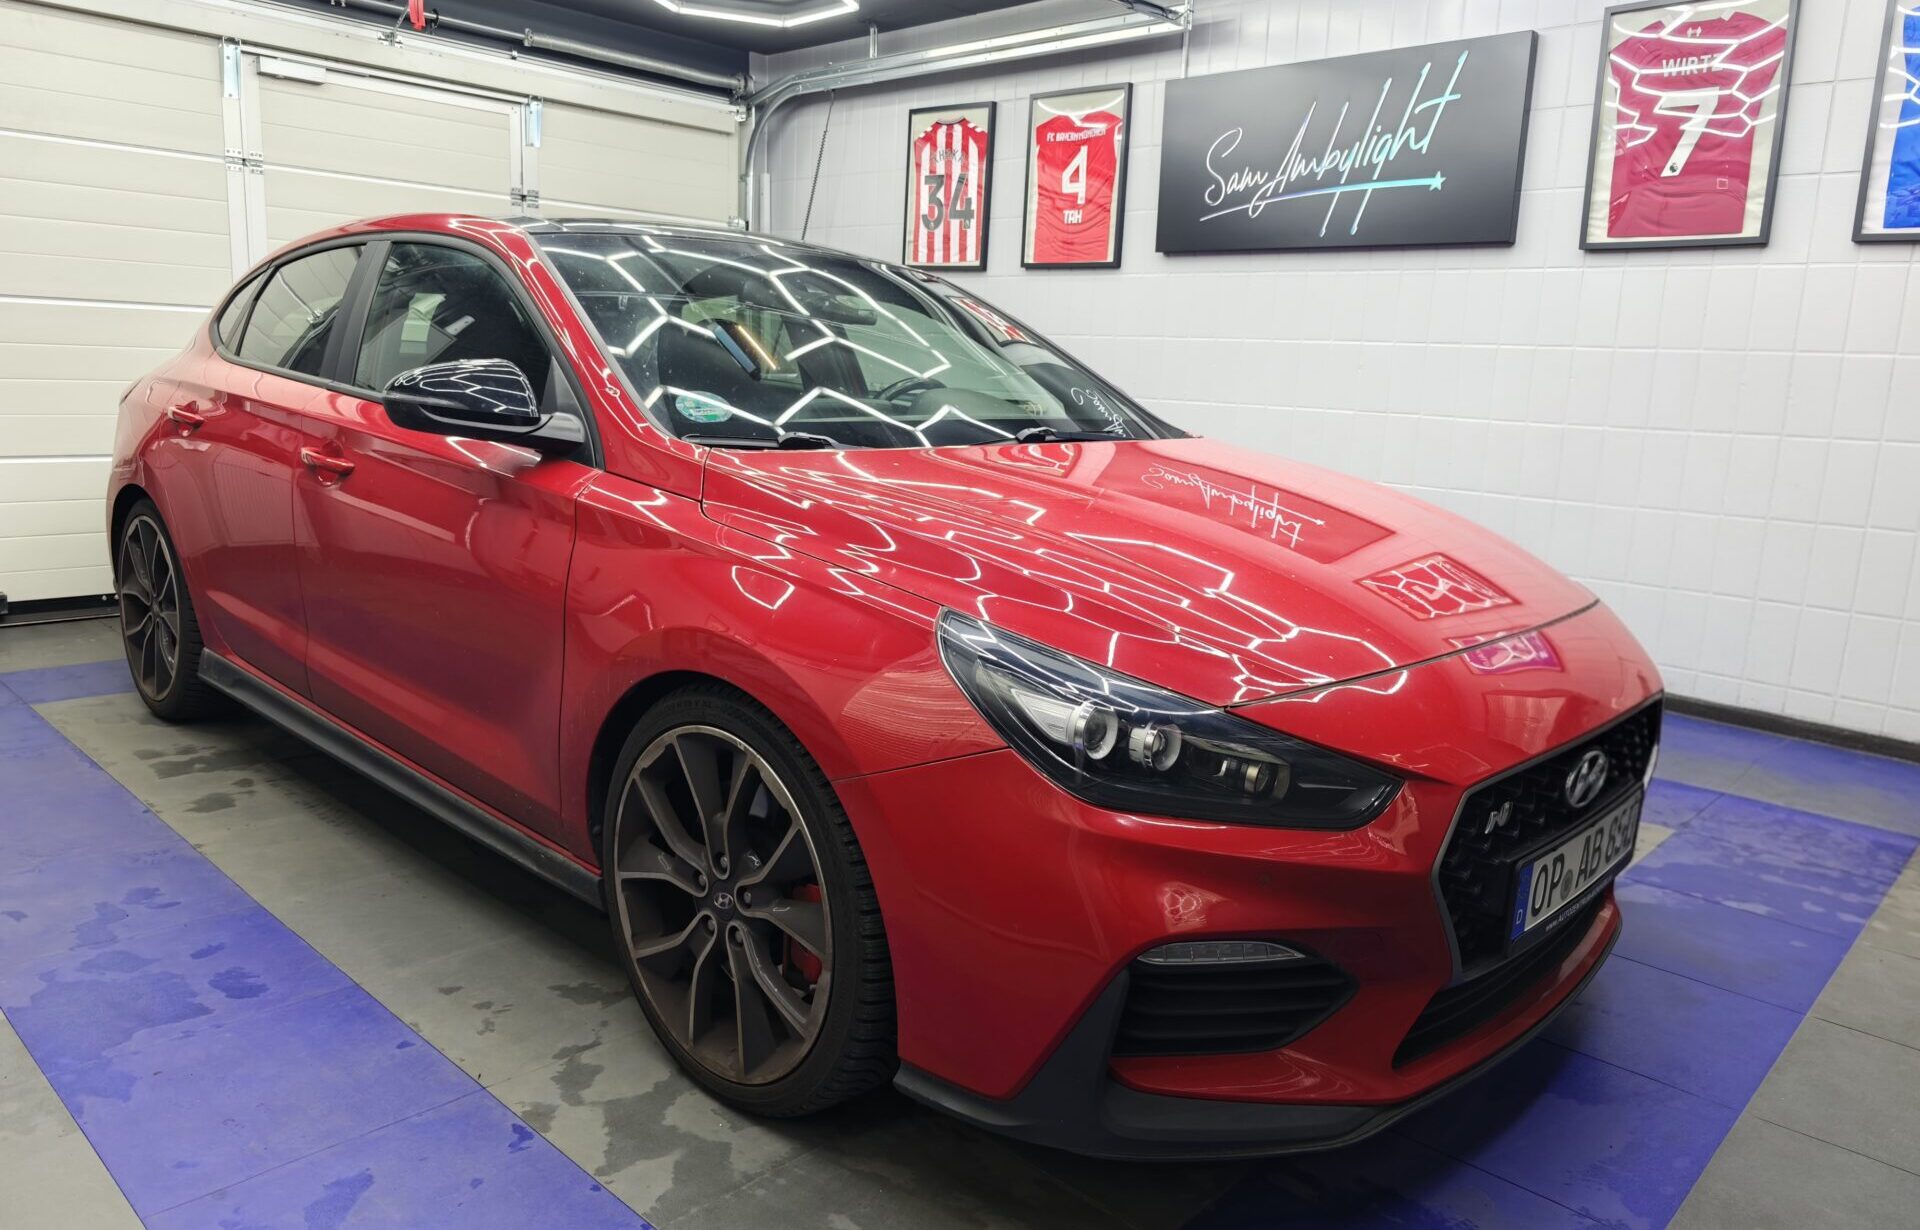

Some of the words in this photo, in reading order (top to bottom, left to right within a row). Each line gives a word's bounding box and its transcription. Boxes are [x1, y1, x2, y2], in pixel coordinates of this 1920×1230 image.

[1662, 53, 1724, 78] WIRTZ
[1046, 131, 1056, 142] FC
[1659, 86, 1720, 178] 7
[1061, 145, 1088, 205] 4
[1204, 126, 1268, 206] Sam
[920, 173, 975, 232] 34
[1530, 853, 1565, 917] OP
[1575, 827, 1604, 889] AB
[1515, 909, 1523, 925] D
